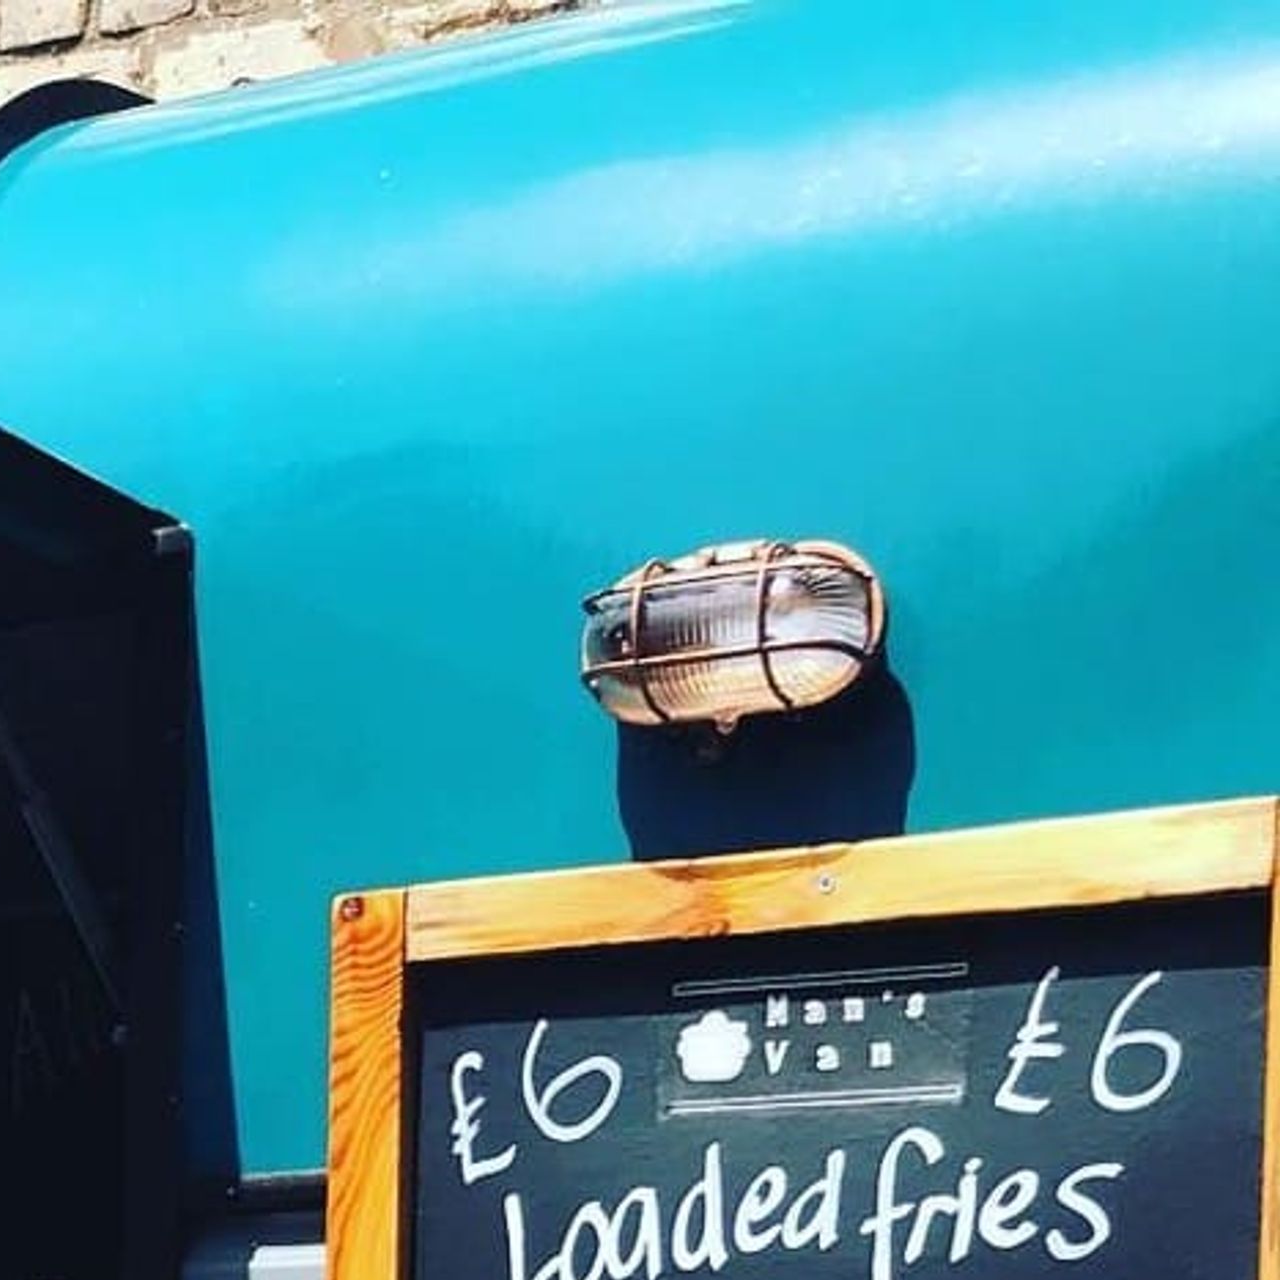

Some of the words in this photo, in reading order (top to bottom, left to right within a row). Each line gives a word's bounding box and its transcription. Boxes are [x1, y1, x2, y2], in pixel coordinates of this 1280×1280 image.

[451, 1018, 623, 1184] £6
[764, 1039, 893, 1075] Van
[994, 965, 1183, 1114] £6
